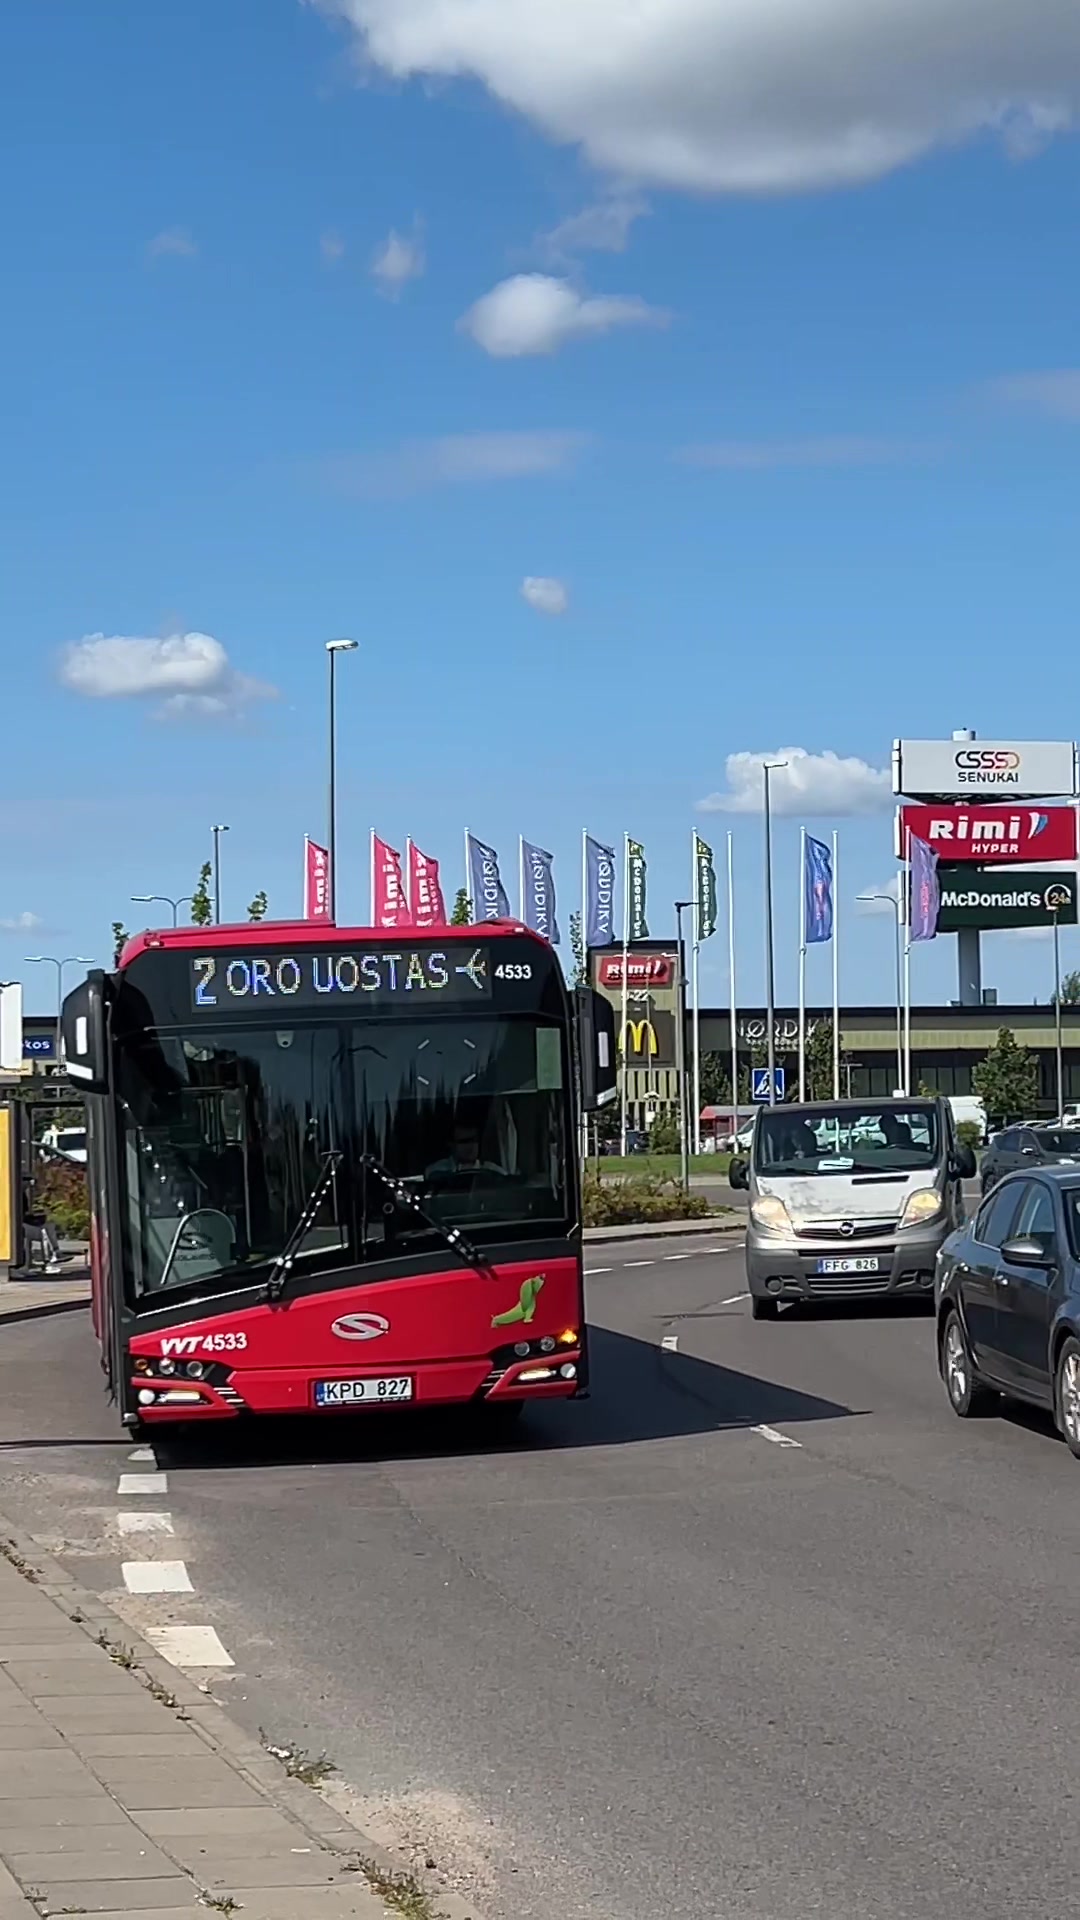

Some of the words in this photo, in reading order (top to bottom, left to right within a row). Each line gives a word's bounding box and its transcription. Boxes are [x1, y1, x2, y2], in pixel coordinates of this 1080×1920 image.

[958, 772, 1018, 782] SENUKAI
[929, 815, 1021, 839] Rimi
[971, 843, 1019, 853] HYPER
[941, 890, 1041, 907] McDonald's
[227, 959, 301, 996] ORO
[312, 953, 448, 993] UOSTAS
[494, 964, 532, 980] 4533
[607, 962, 652, 974] Rmi
[202, 1333, 247, 1351] 4533
[326, 1382, 365, 1399] KPD
[377, 1379, 409, 1396] 827
